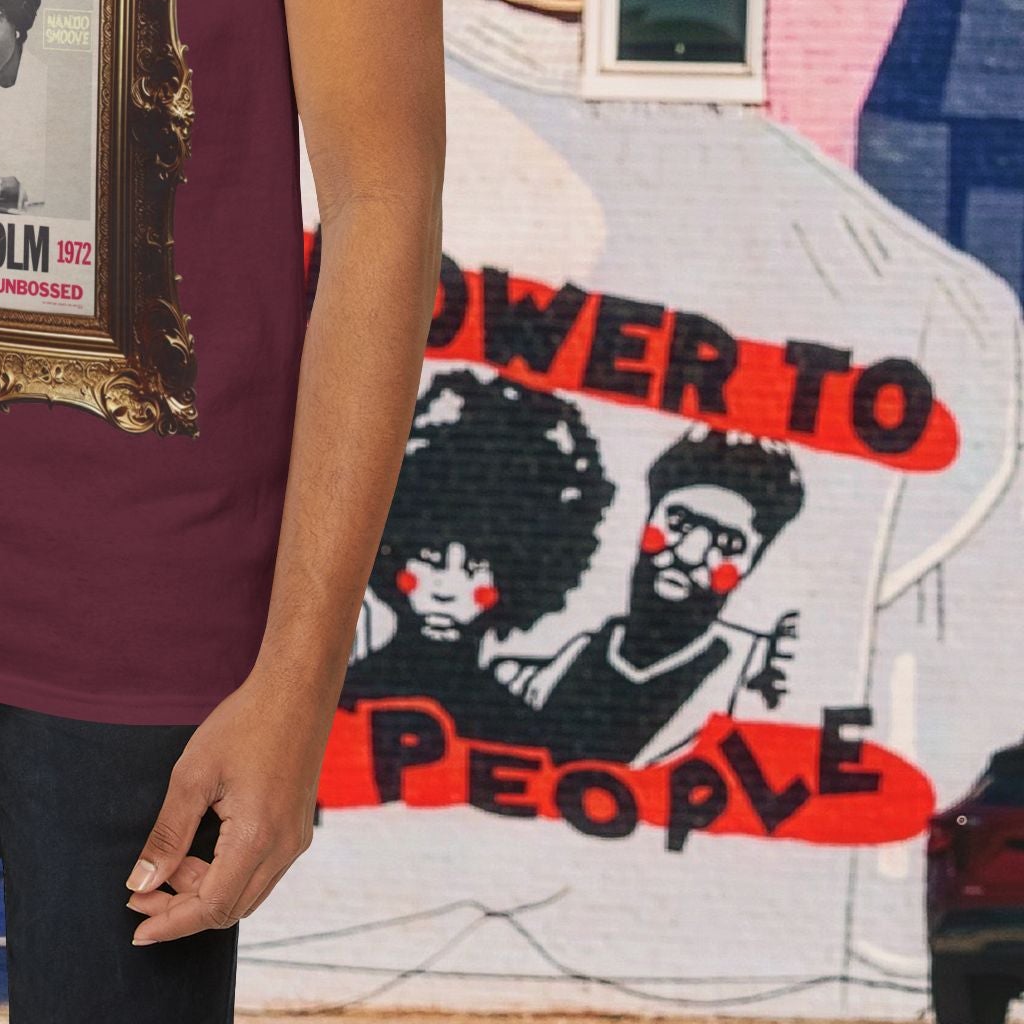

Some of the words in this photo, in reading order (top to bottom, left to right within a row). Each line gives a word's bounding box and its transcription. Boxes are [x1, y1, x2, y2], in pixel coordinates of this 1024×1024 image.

[57, 240, 92, 265] 1972
[784, 339, 934, 454] TO
[370, 705, 882, 852] PEOPLE
